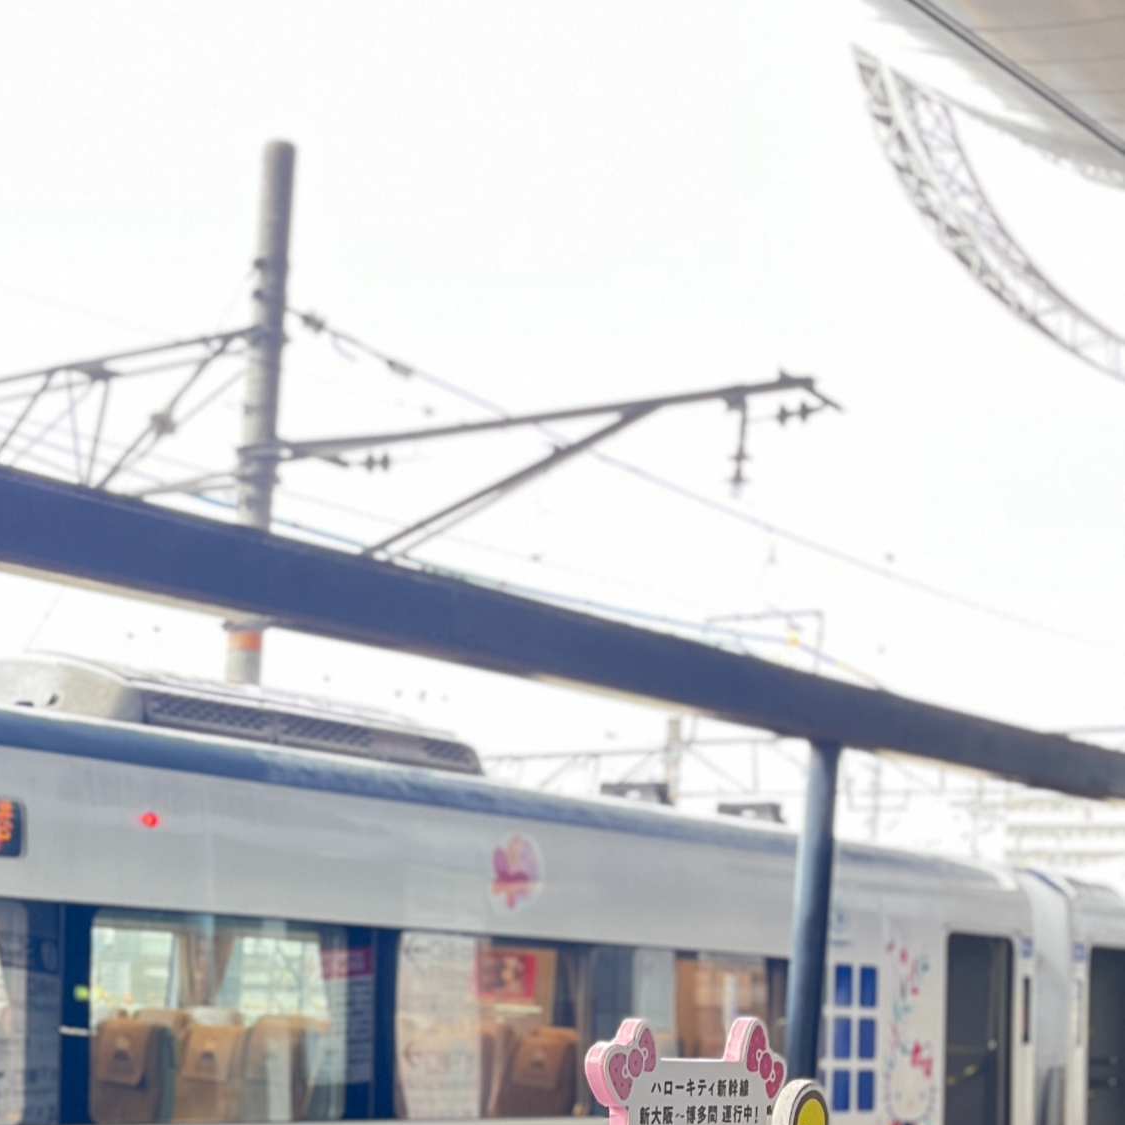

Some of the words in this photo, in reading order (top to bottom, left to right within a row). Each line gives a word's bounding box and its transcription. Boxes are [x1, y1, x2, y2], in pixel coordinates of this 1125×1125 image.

[650, 1078, 750, 1098] ハローキティ新幹線
